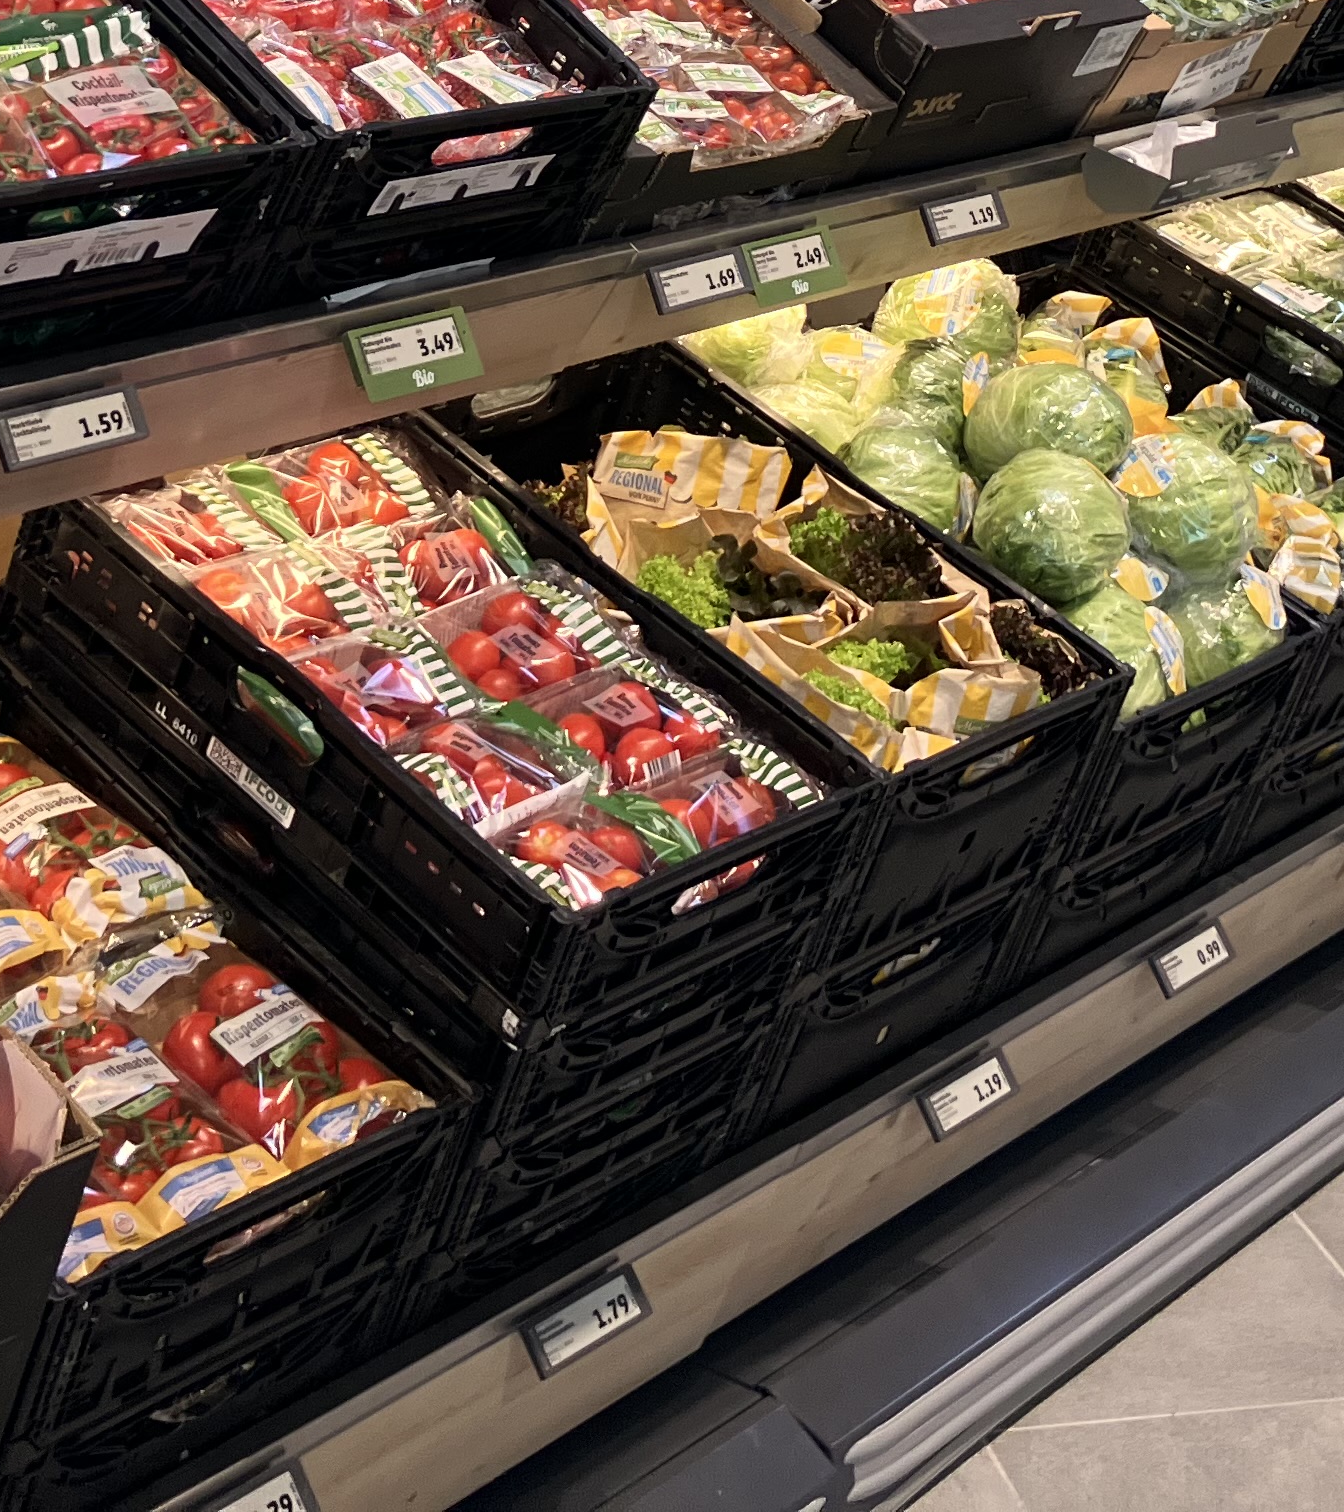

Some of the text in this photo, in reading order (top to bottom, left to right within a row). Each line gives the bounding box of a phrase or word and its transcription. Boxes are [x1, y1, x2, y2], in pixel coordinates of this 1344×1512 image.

[70, 73, 125, 93] Cocktail-
[968, 206, 995, 227] 1.19
[794, 246, 823, 269] 2.49
[705, 267, 736, 290] 1.69
[791, 279, 810, 295] Bio
[416, 330, 455, 357] 3.49
[411, 368, 436, 388] Bio
[77, 409, 124, 439] 1.59
[608, 469, 664, 496] REGIONAL
[172, 717, 198, 746] 6410
[243, 768, 276, 805] IFCO
[0, 794, 89, 836] Rispentomaten
[1196, 940, 1221, 966] 0.99
[220, 997, 305, 1046] Rispentomaten
[973, 1072, 1002, 1103] 1.19
[592, 1292, 629, 1330] 1.79
